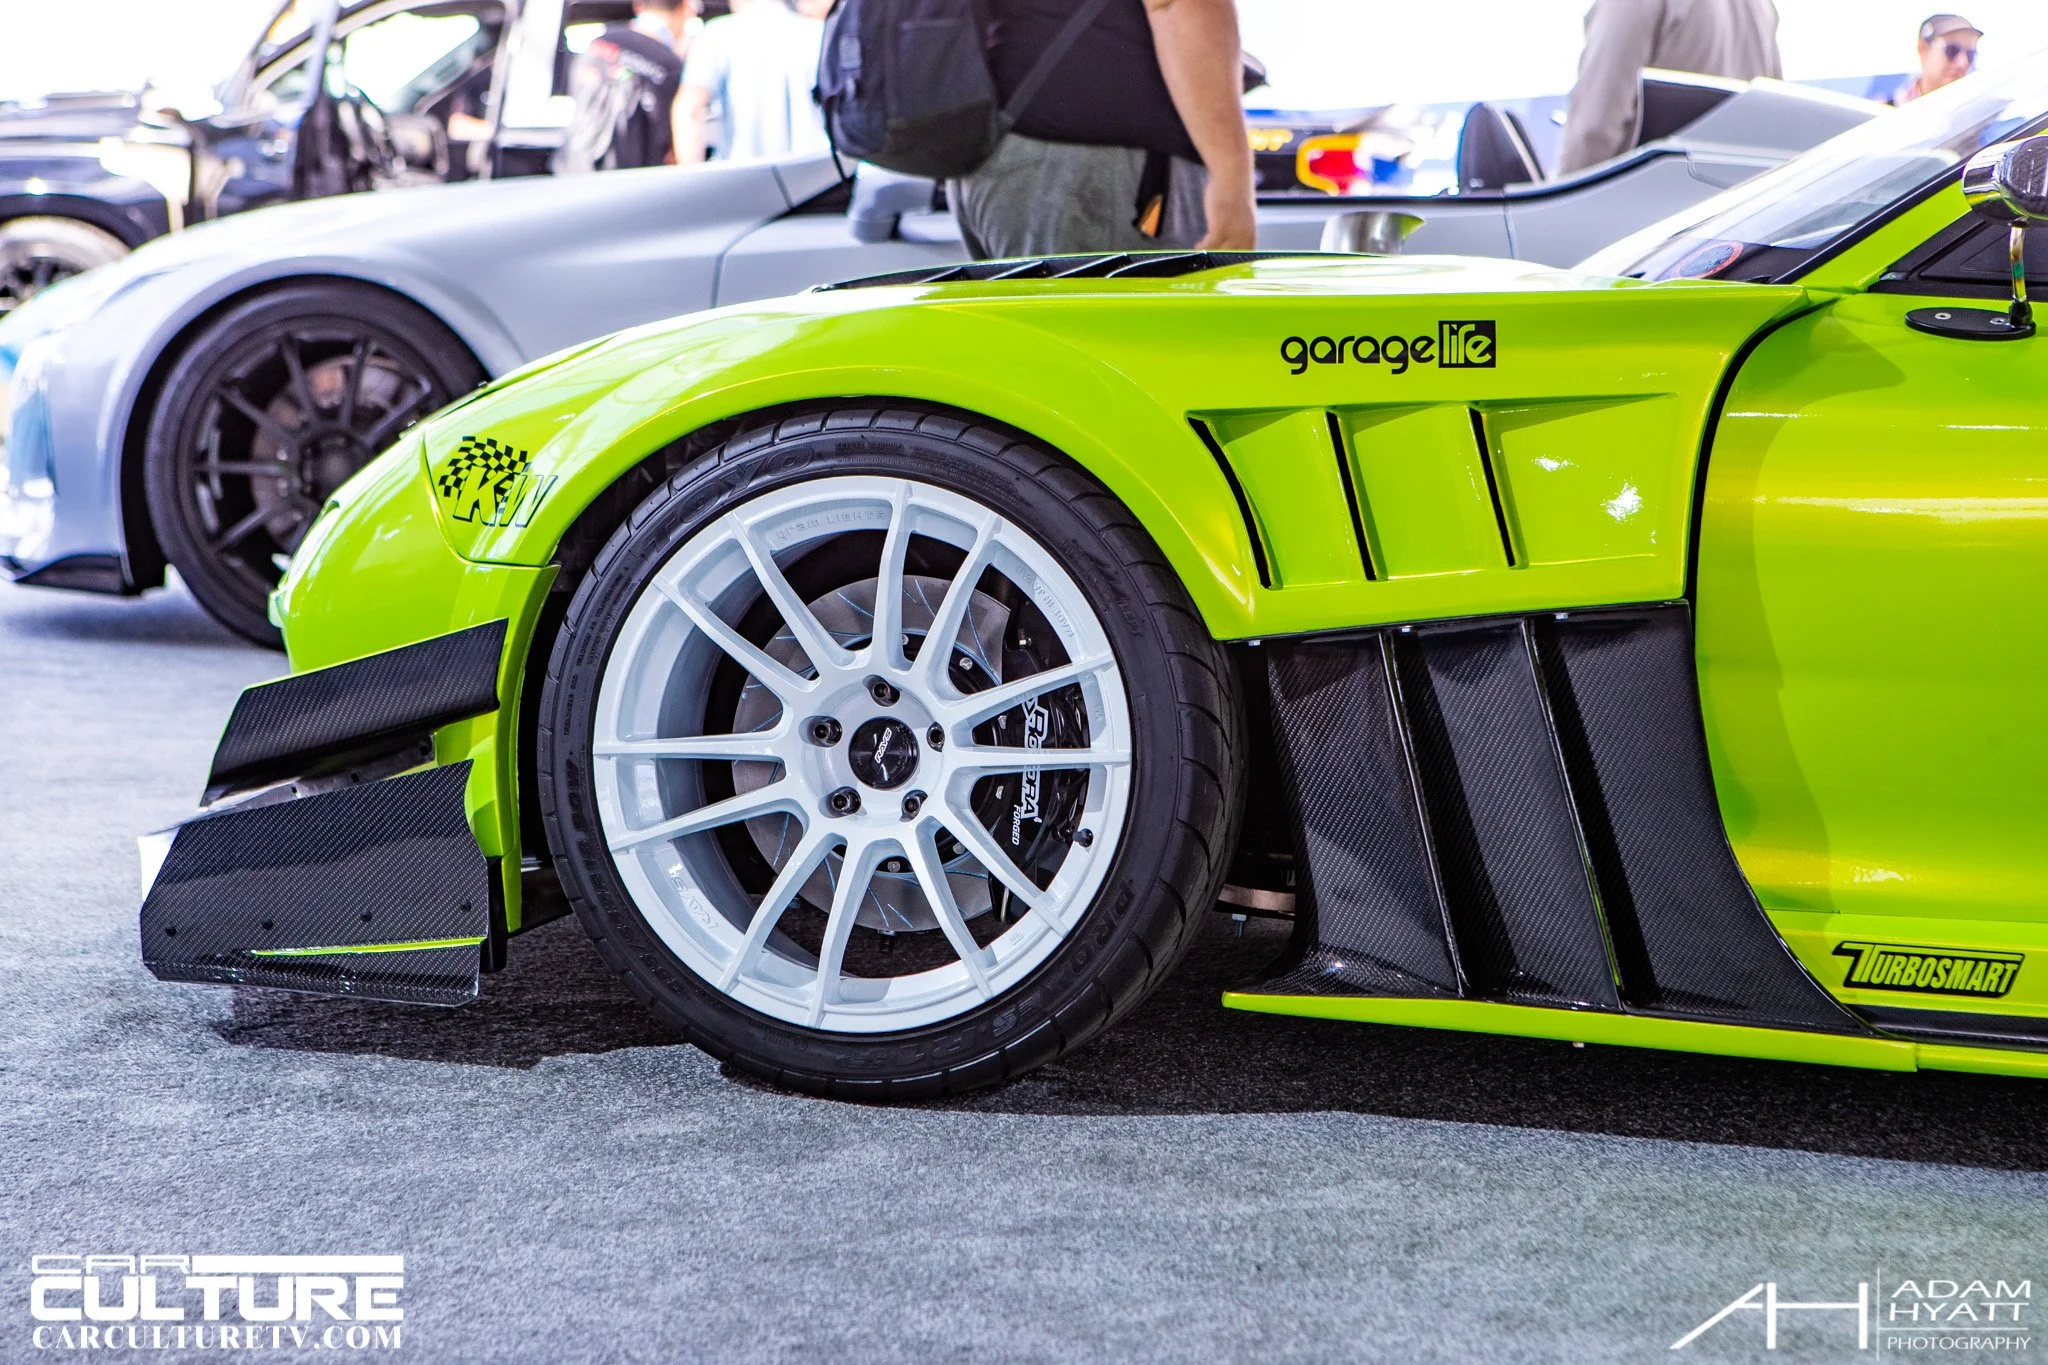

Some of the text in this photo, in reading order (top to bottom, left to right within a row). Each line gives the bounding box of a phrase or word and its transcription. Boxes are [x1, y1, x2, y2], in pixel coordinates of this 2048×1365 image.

[1280, 335, 1436, 375] garage
[452, 465, 558, 528] KW
[1011, 804, 1021, 846] FORGED
[1841, 941, 2024, 994] TURBOSMART
